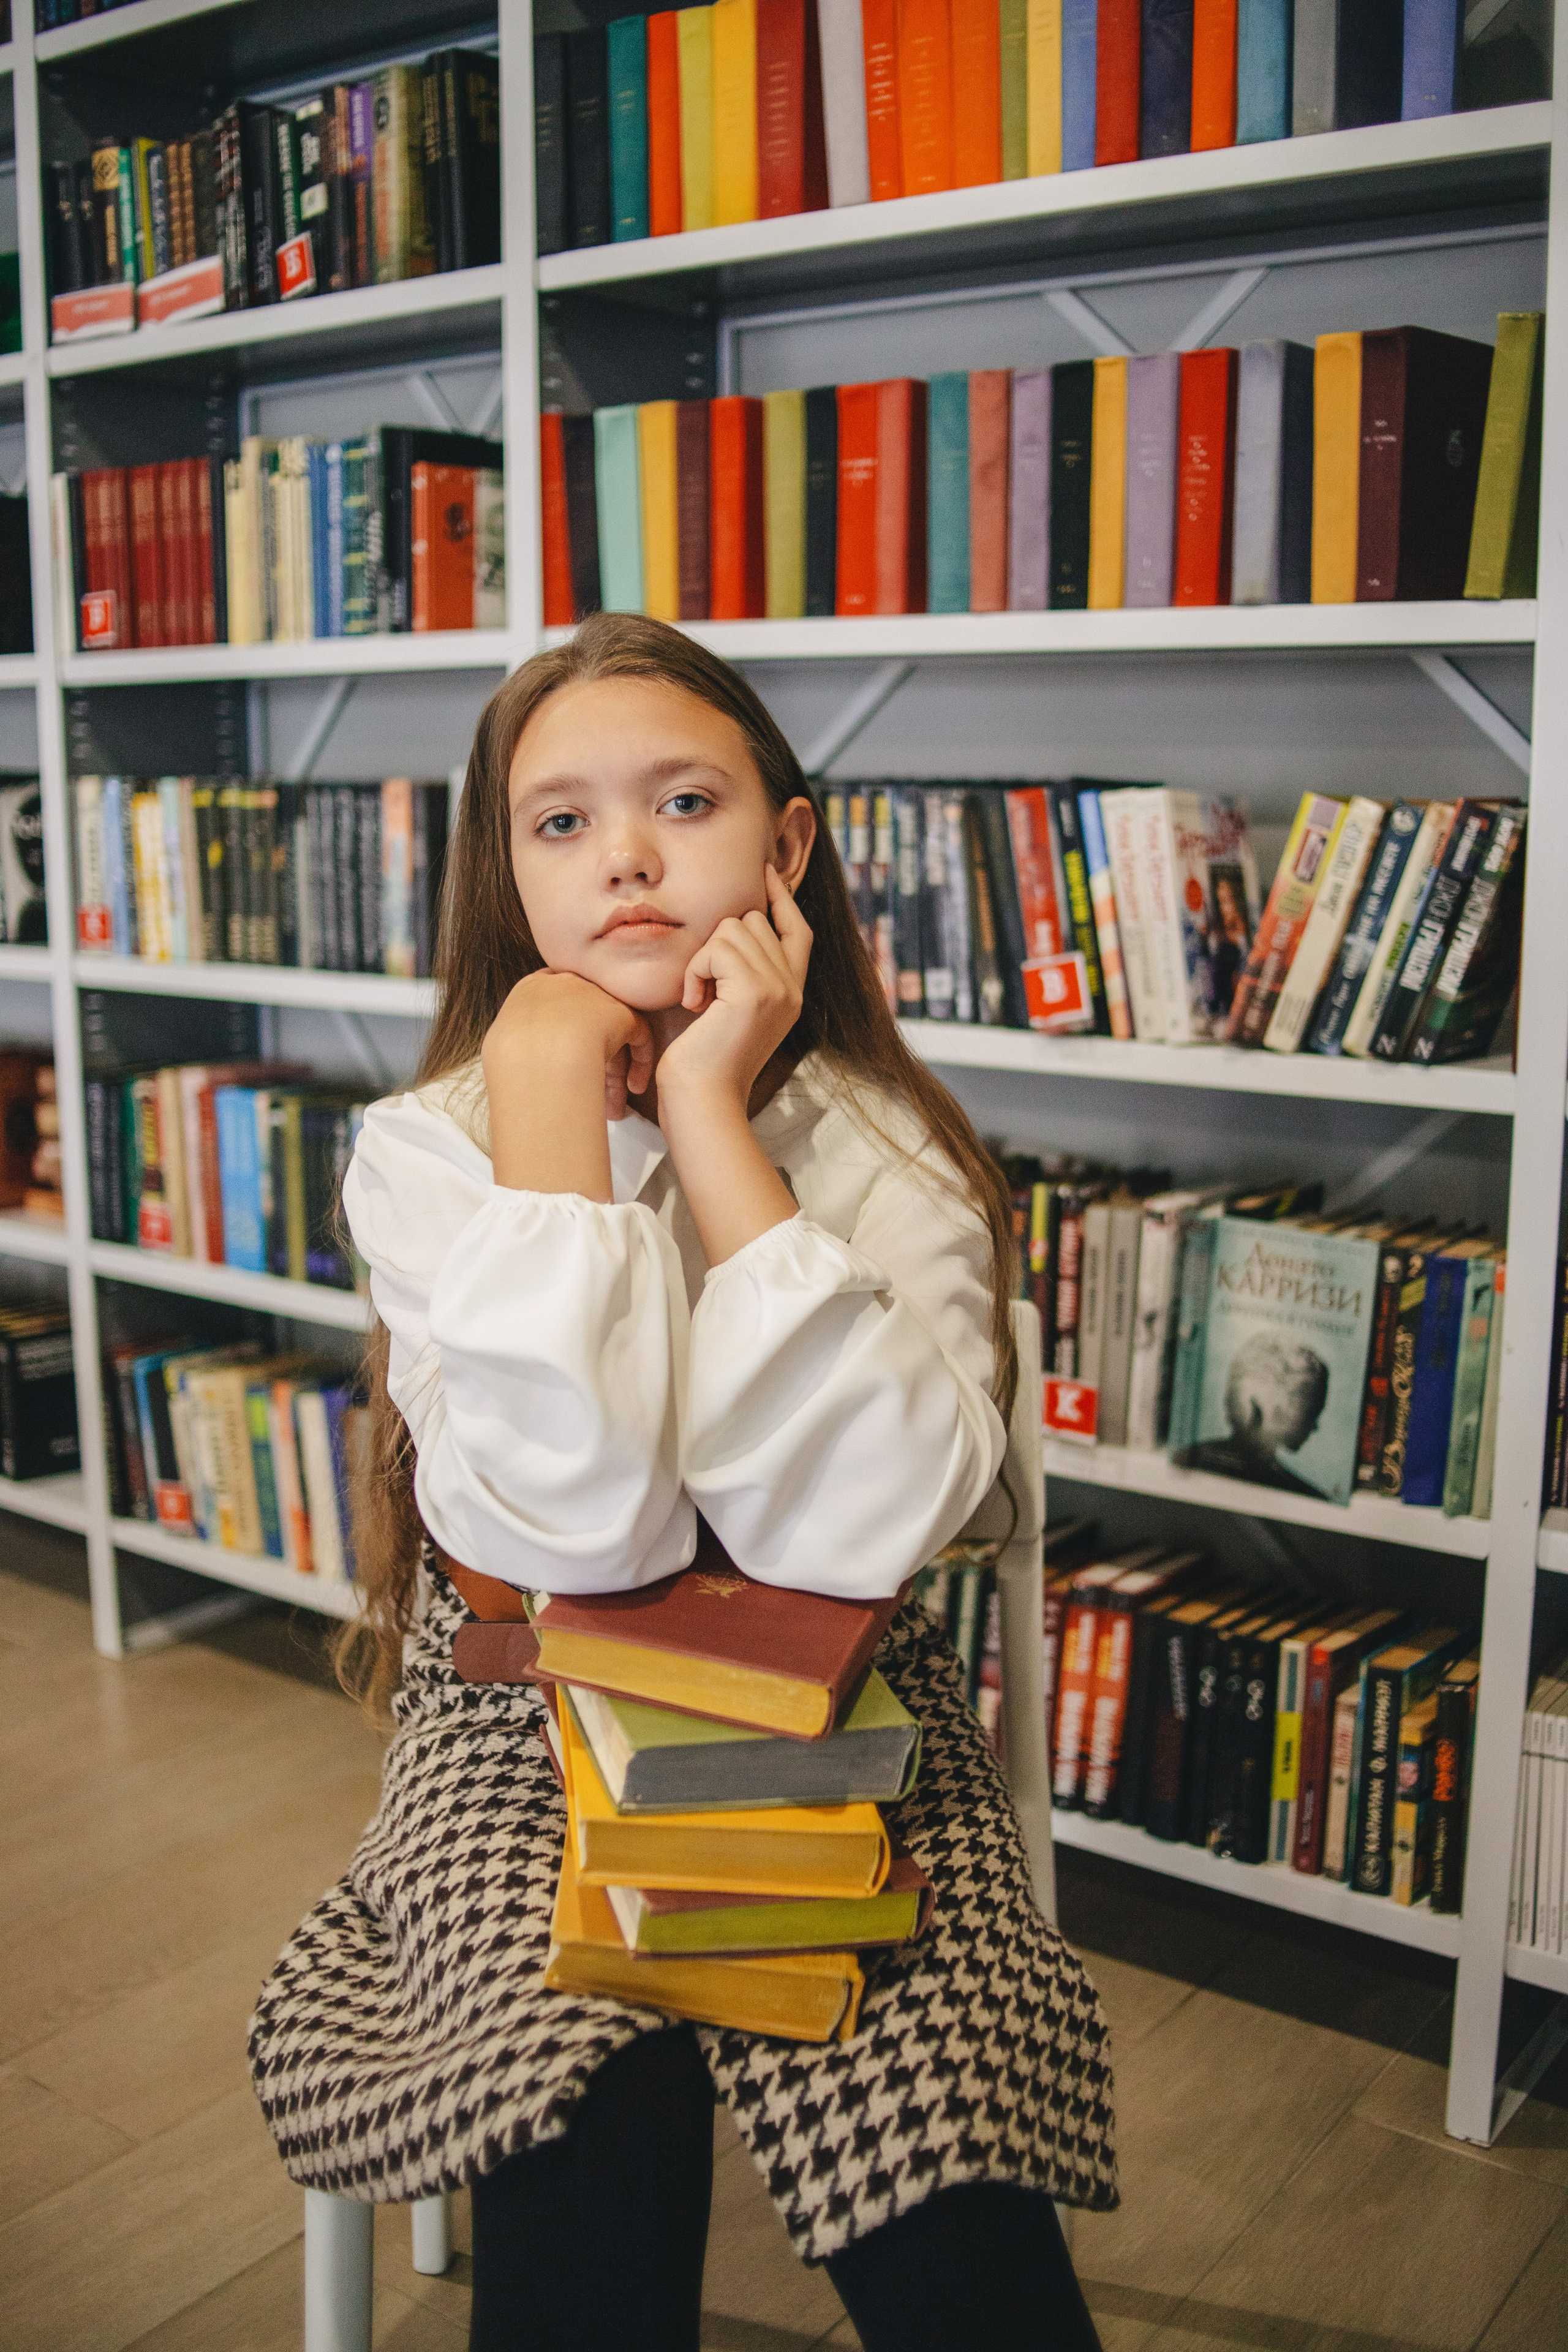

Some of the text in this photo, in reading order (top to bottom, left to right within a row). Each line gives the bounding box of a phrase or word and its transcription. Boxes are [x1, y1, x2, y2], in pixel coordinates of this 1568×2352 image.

[1398, 919, 1445, 992] ГРИШЭМ
[1436, 920, 1480, 997] ГРИШЭМ
[1216, 1264, 1362, 1316] КАРРИЗИ
[1373, 1678, 1392, 1752] МАРРИЭТ
[1364, 1778, 1385, 1853] КАПИТАН
